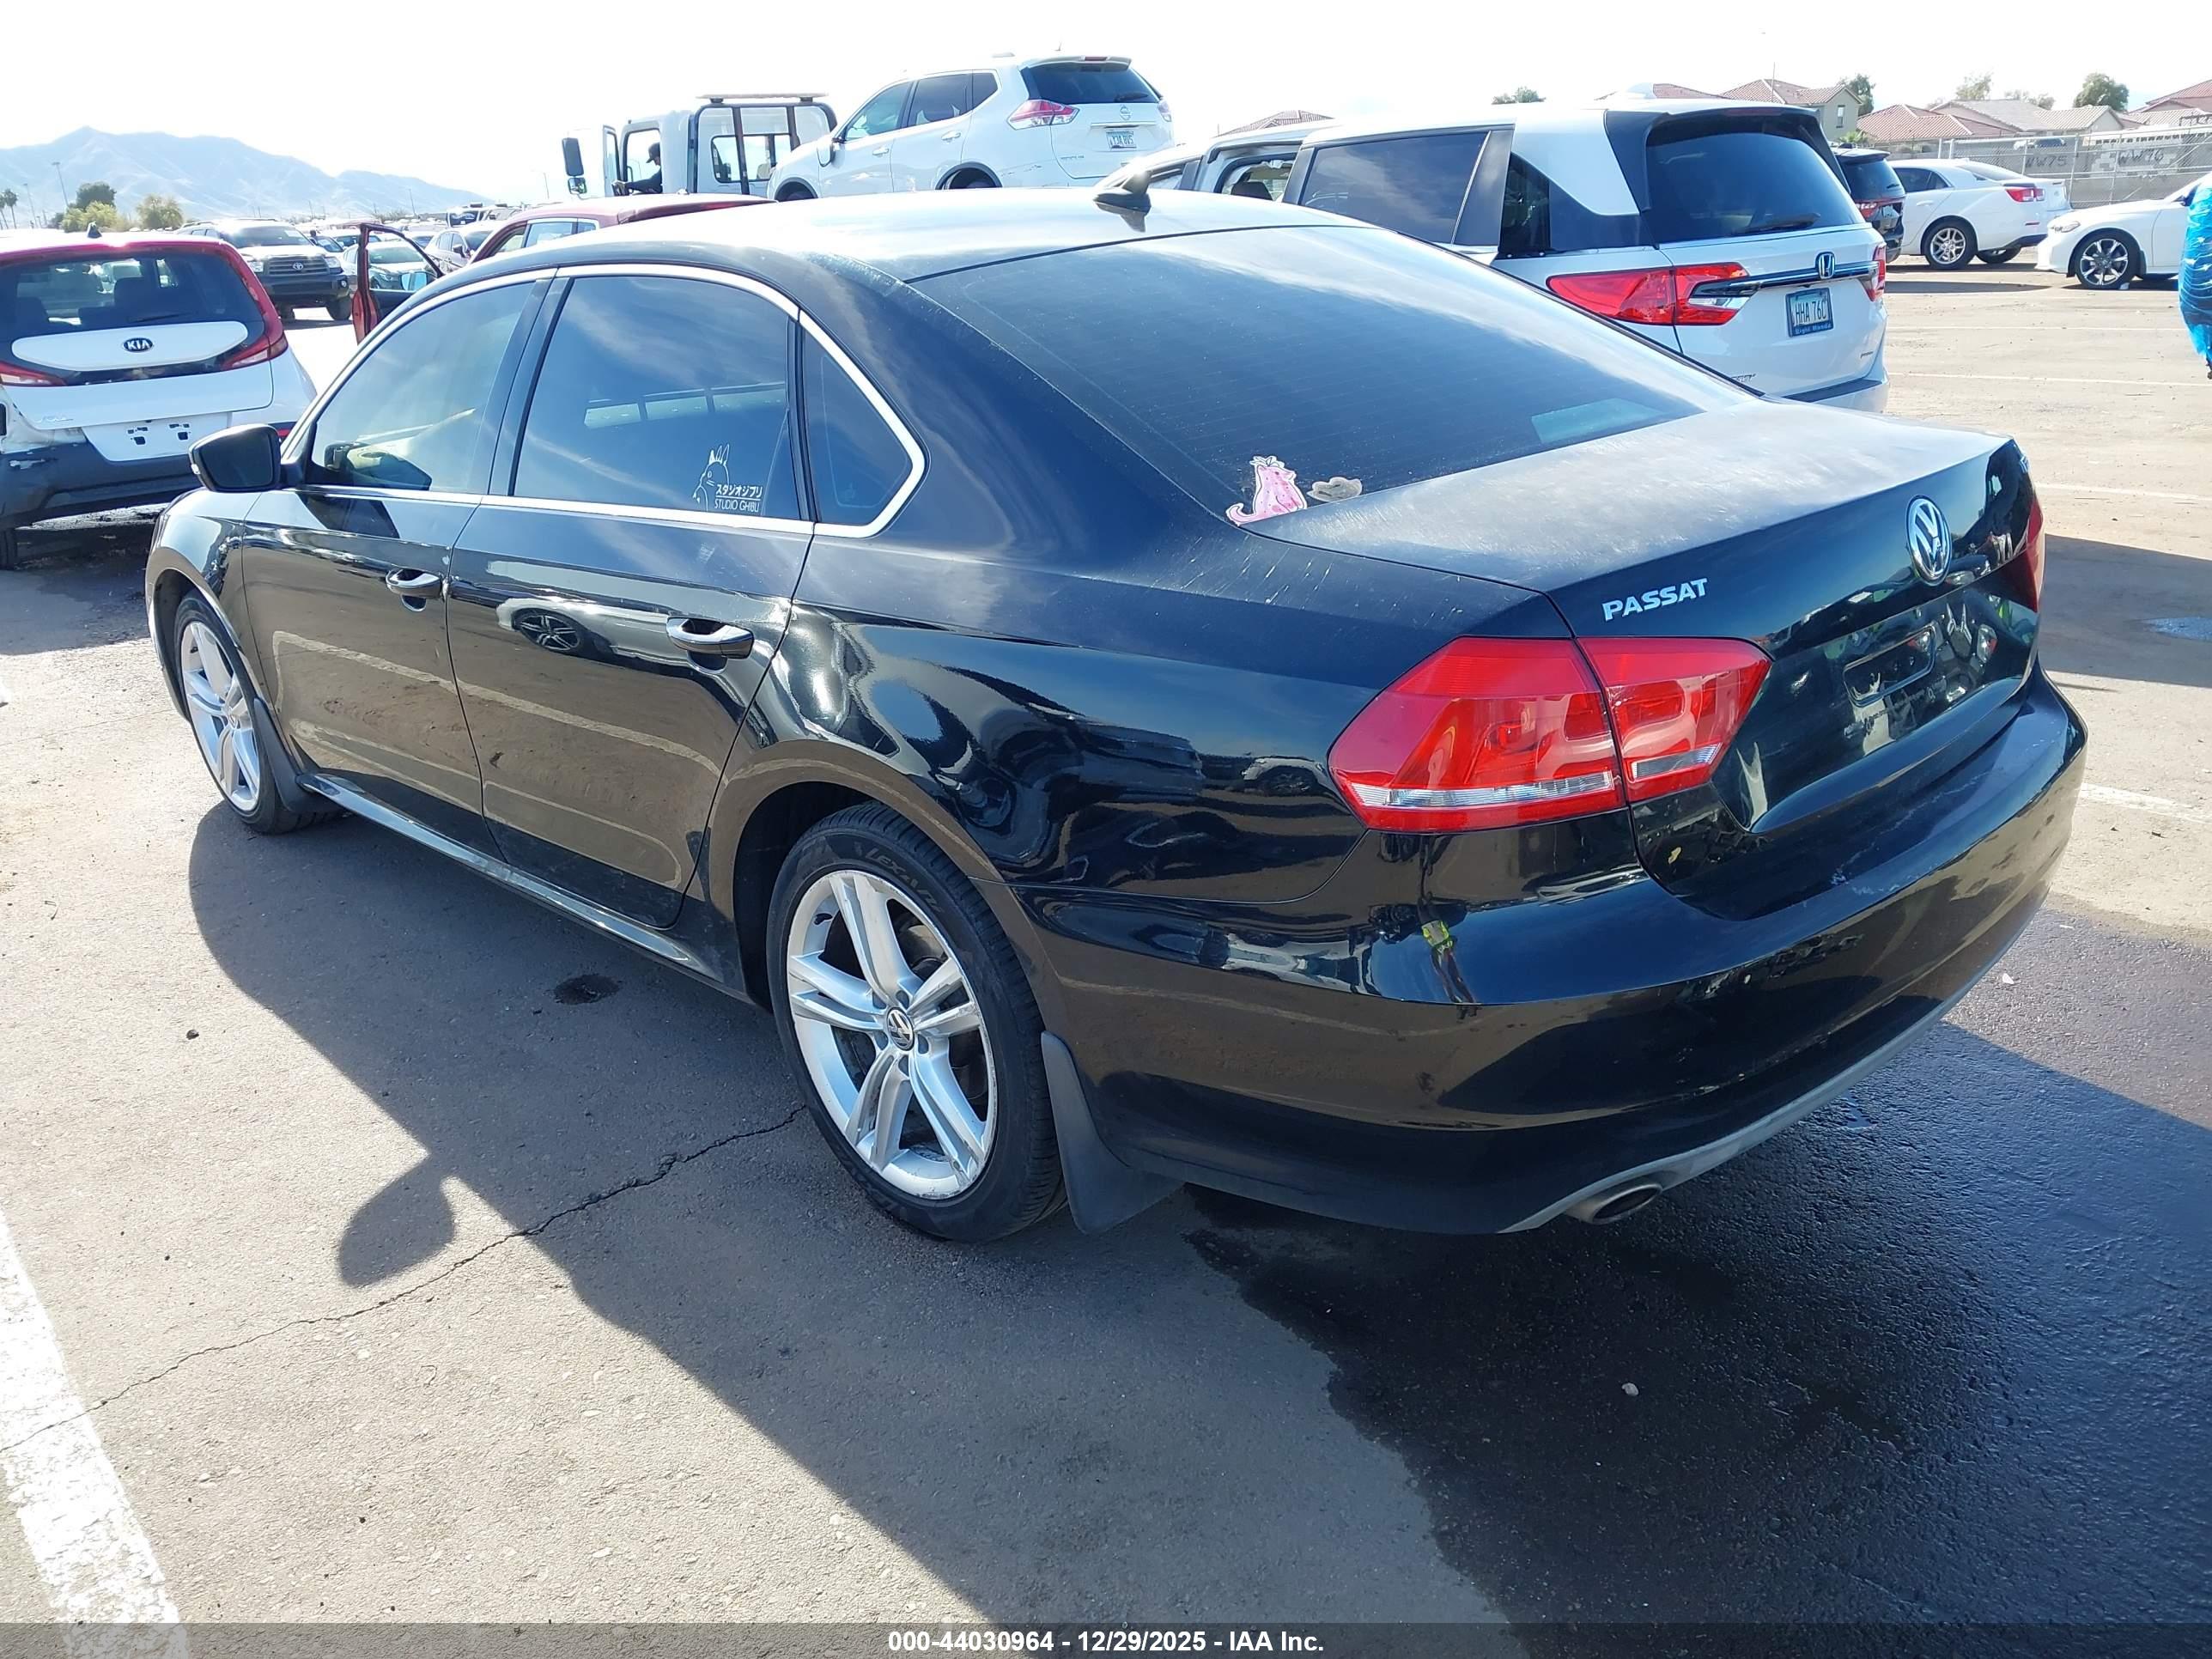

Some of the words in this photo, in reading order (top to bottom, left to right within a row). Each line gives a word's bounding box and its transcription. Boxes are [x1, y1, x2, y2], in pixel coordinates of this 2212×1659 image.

[127, 340, 149, 350] KIA
[714, 498, 738, 510] STUDIO
[739, 500, 760, 513] GHIBLI
[1601, 578, 1709, 622] PASSAT
